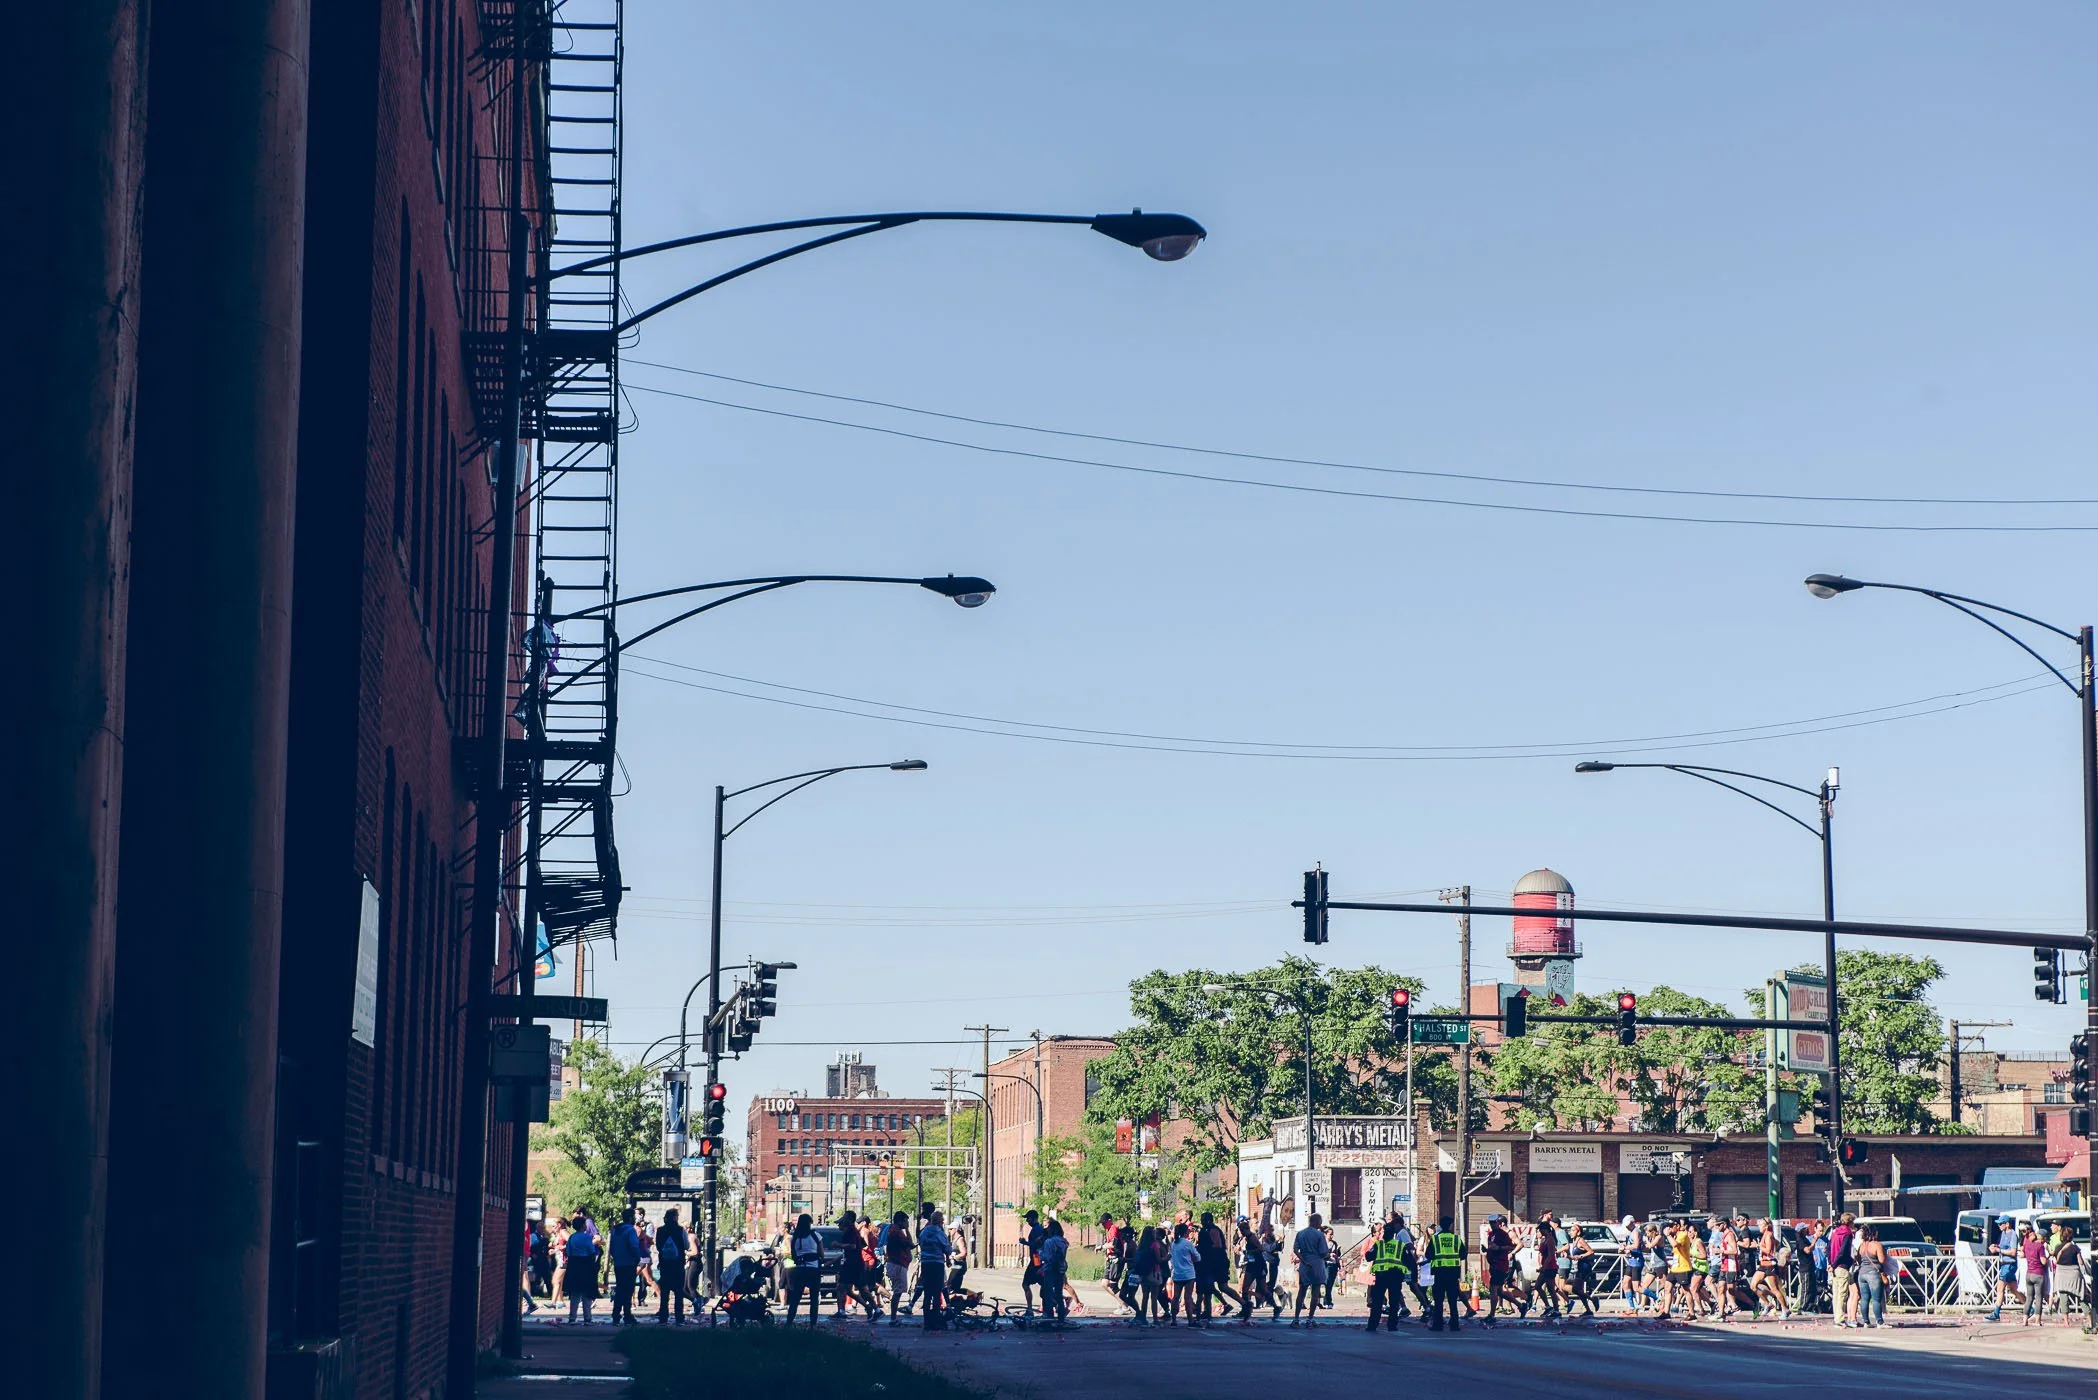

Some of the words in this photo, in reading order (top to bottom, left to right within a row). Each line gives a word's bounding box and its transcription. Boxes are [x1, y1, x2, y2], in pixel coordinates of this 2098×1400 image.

[1809, 991, 1827, 1008] GRIL
[1420, 1024, 1458, 1033] HALSTED
[1797, 1040, 1823, 1058] GYROS
[764, 1099, 795, 1112] 1100
[1534, 1146, 1567, 1154] BARRY'S
[1364, 1169, 1381, 1177] 820
[1304, 1183, 1321, 1193] 30
